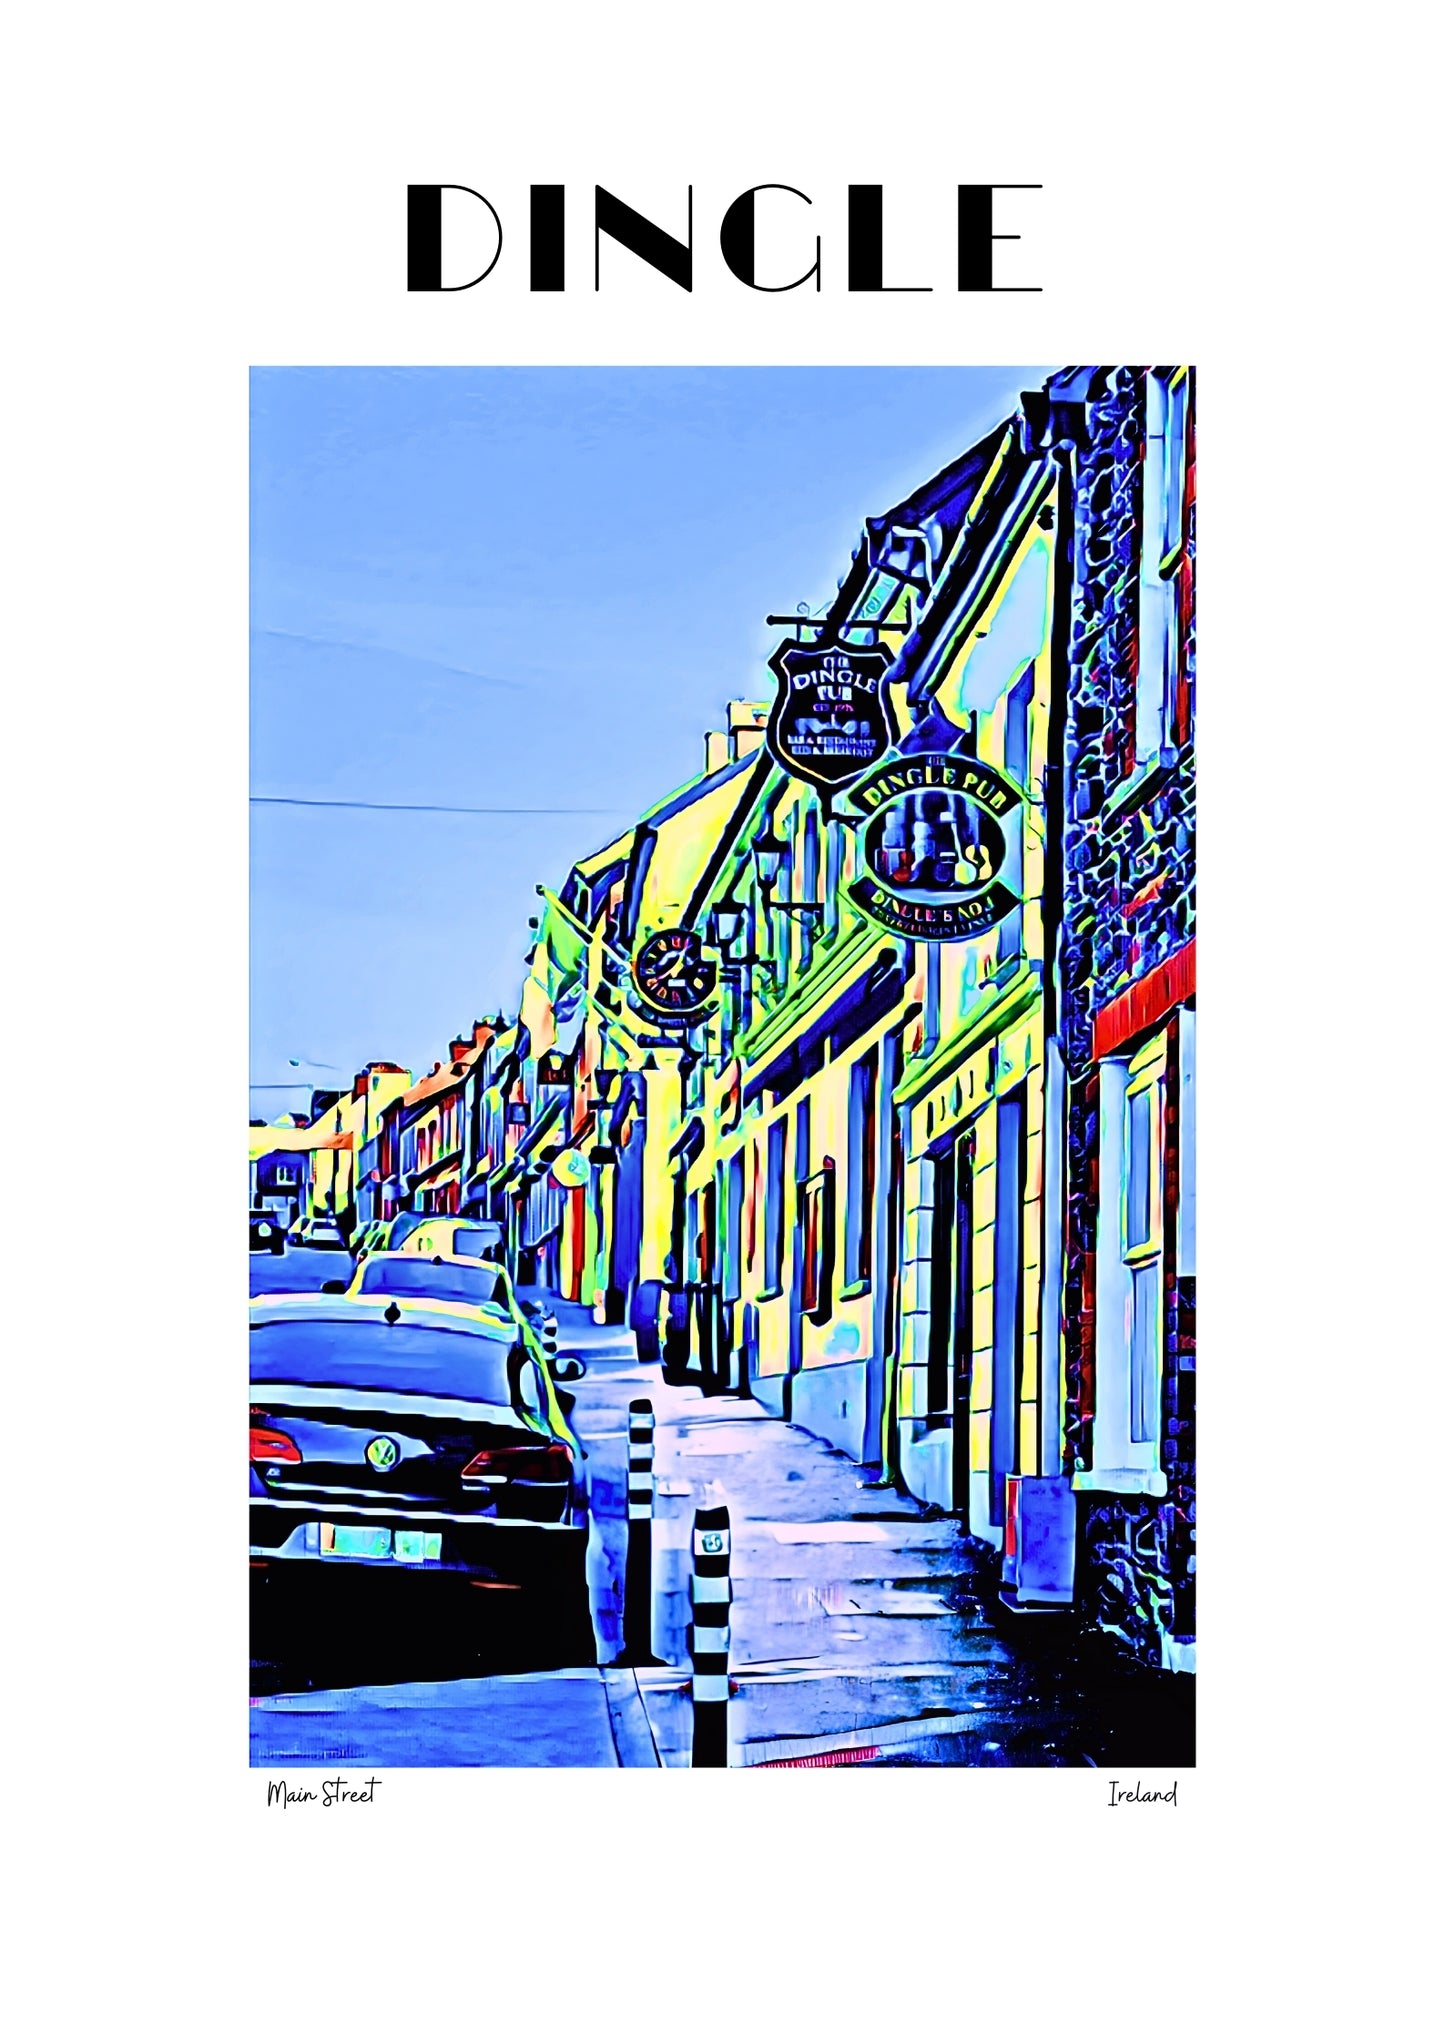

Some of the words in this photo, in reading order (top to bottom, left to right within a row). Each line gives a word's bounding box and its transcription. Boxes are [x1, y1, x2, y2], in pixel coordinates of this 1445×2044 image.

[792, 669, 877, 694] DINGLE
[862, 767, 956, 807] DINGLE
[962, 772, 1007, 810] PUB
